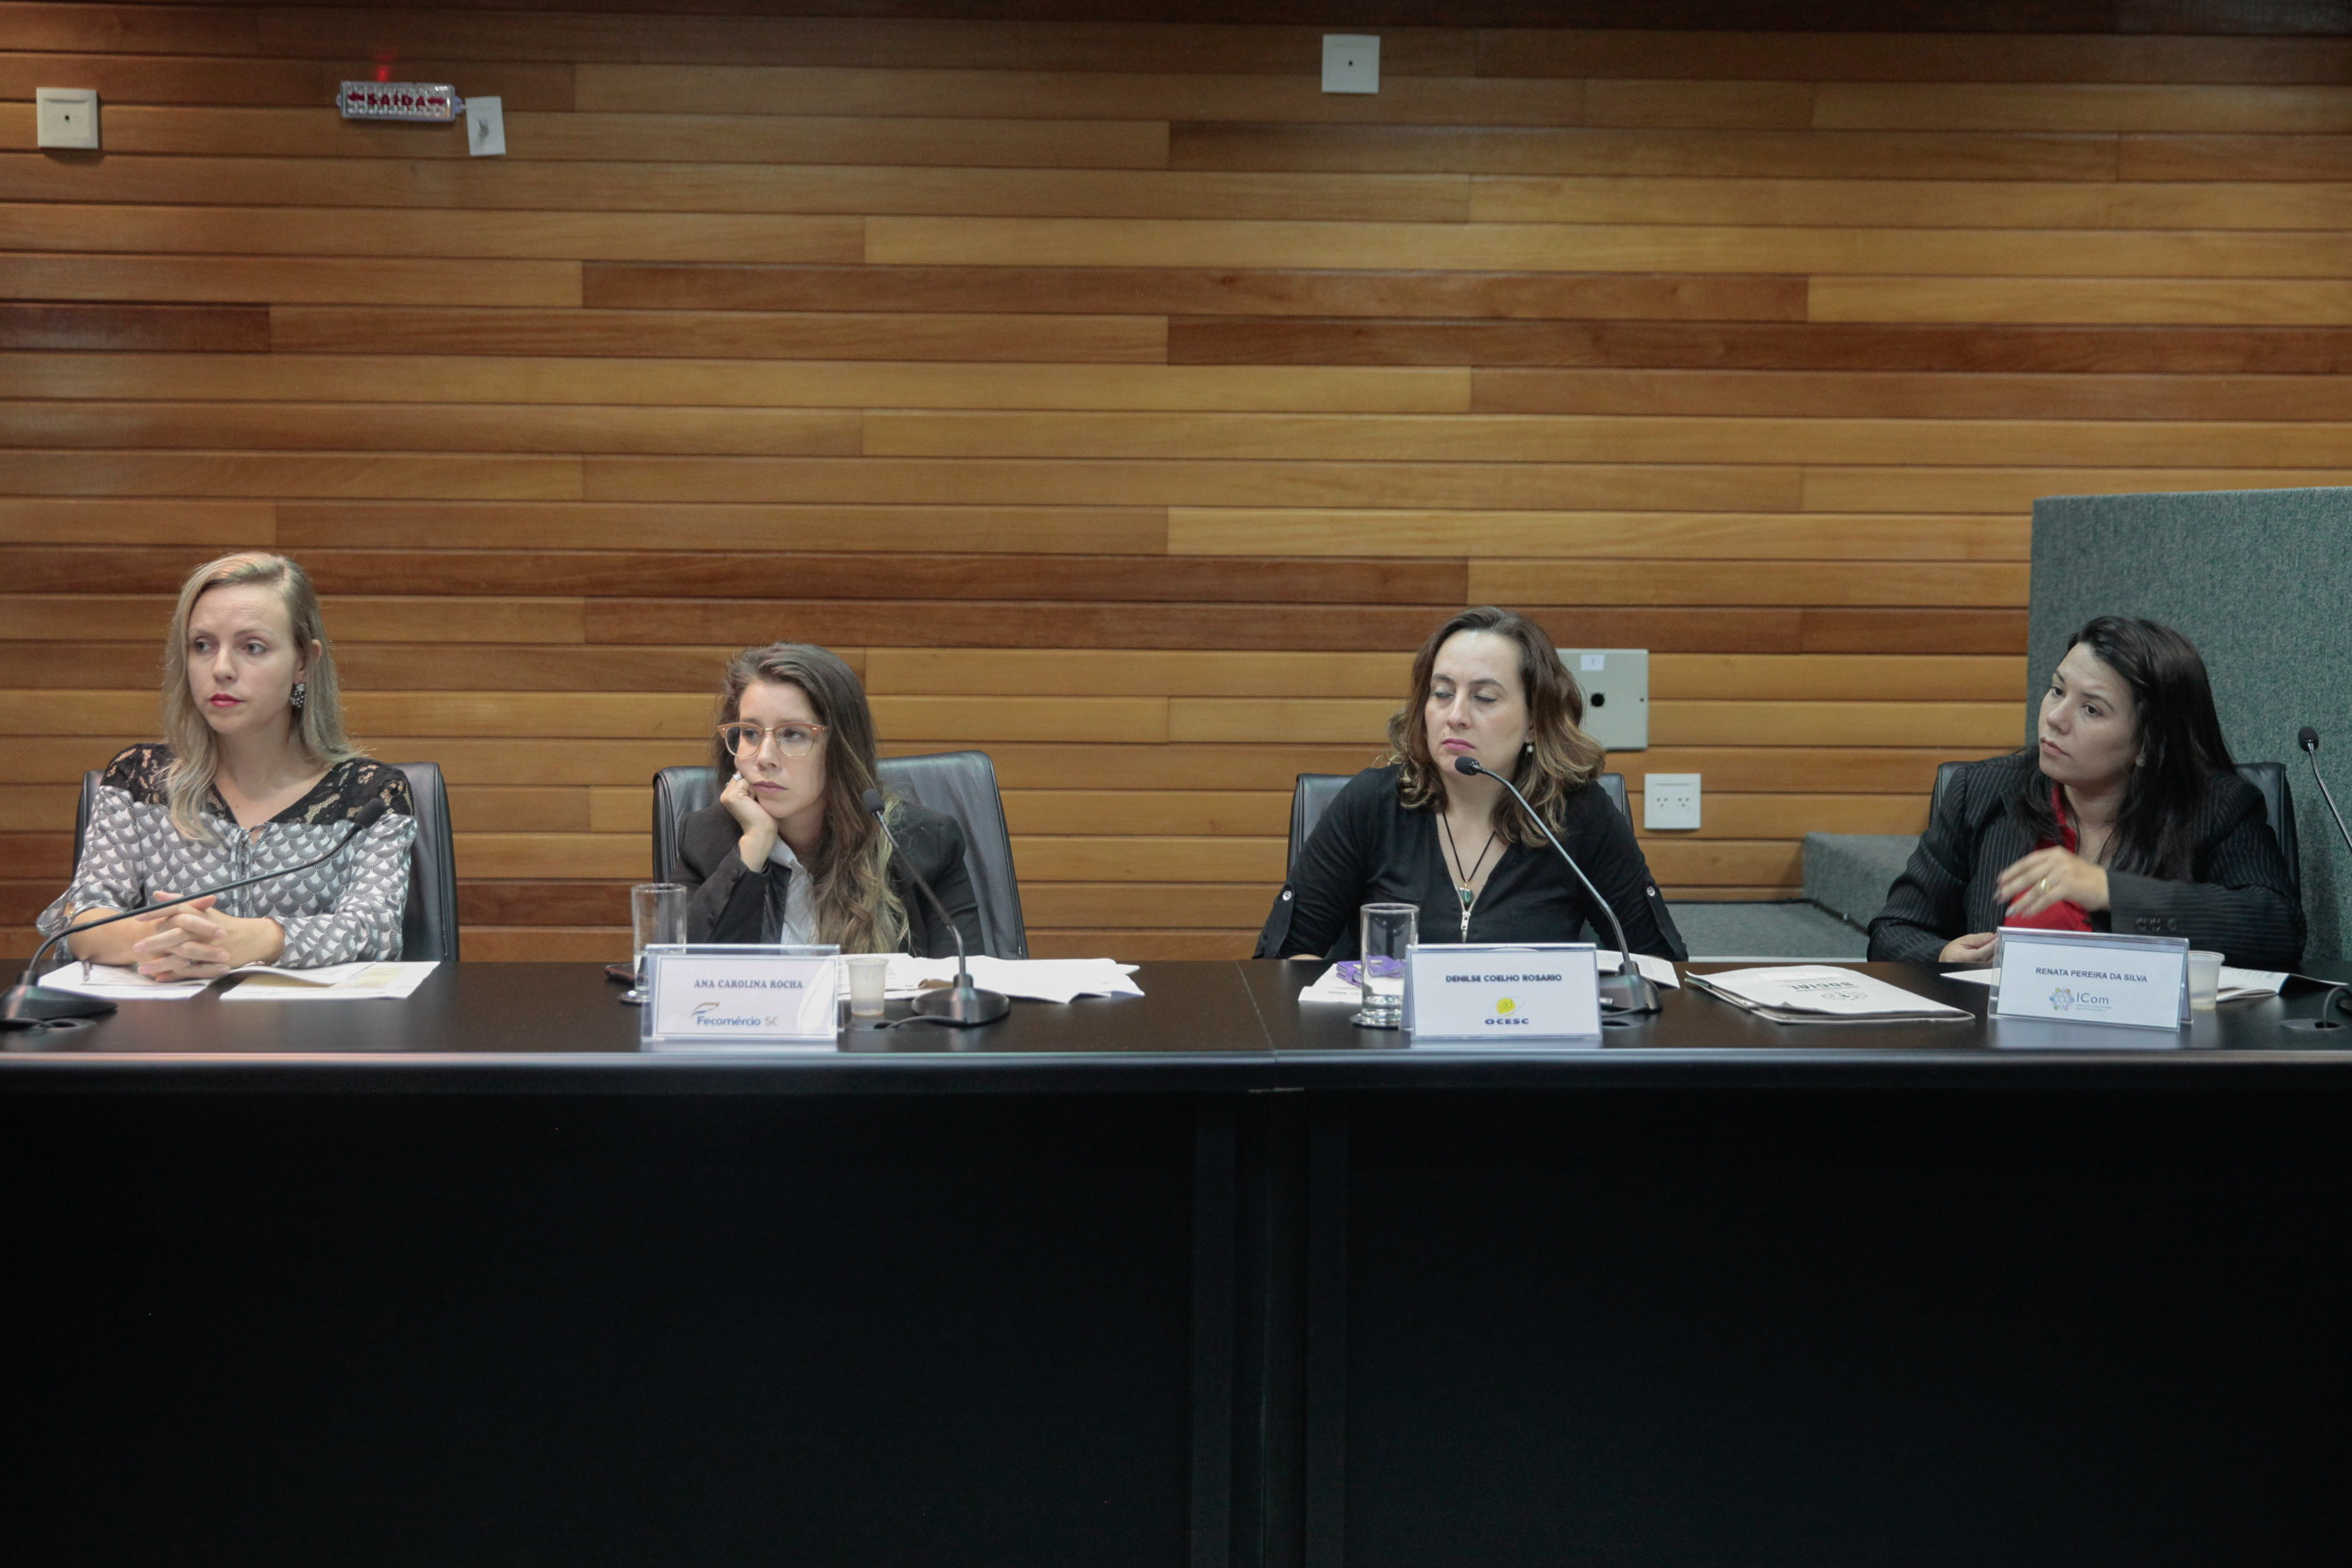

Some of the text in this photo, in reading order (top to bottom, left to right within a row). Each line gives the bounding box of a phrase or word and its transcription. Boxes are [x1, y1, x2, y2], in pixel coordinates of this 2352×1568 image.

[2035, 966, 2149, 982] RENATA PEREIRA DA SILVA
[694, 980, 803, 988] ANA CAROLINA ROCHA
[2076, 992, 2110, 1005] ICom
[697, 1015, 778, 1026] Fecomércio SC
